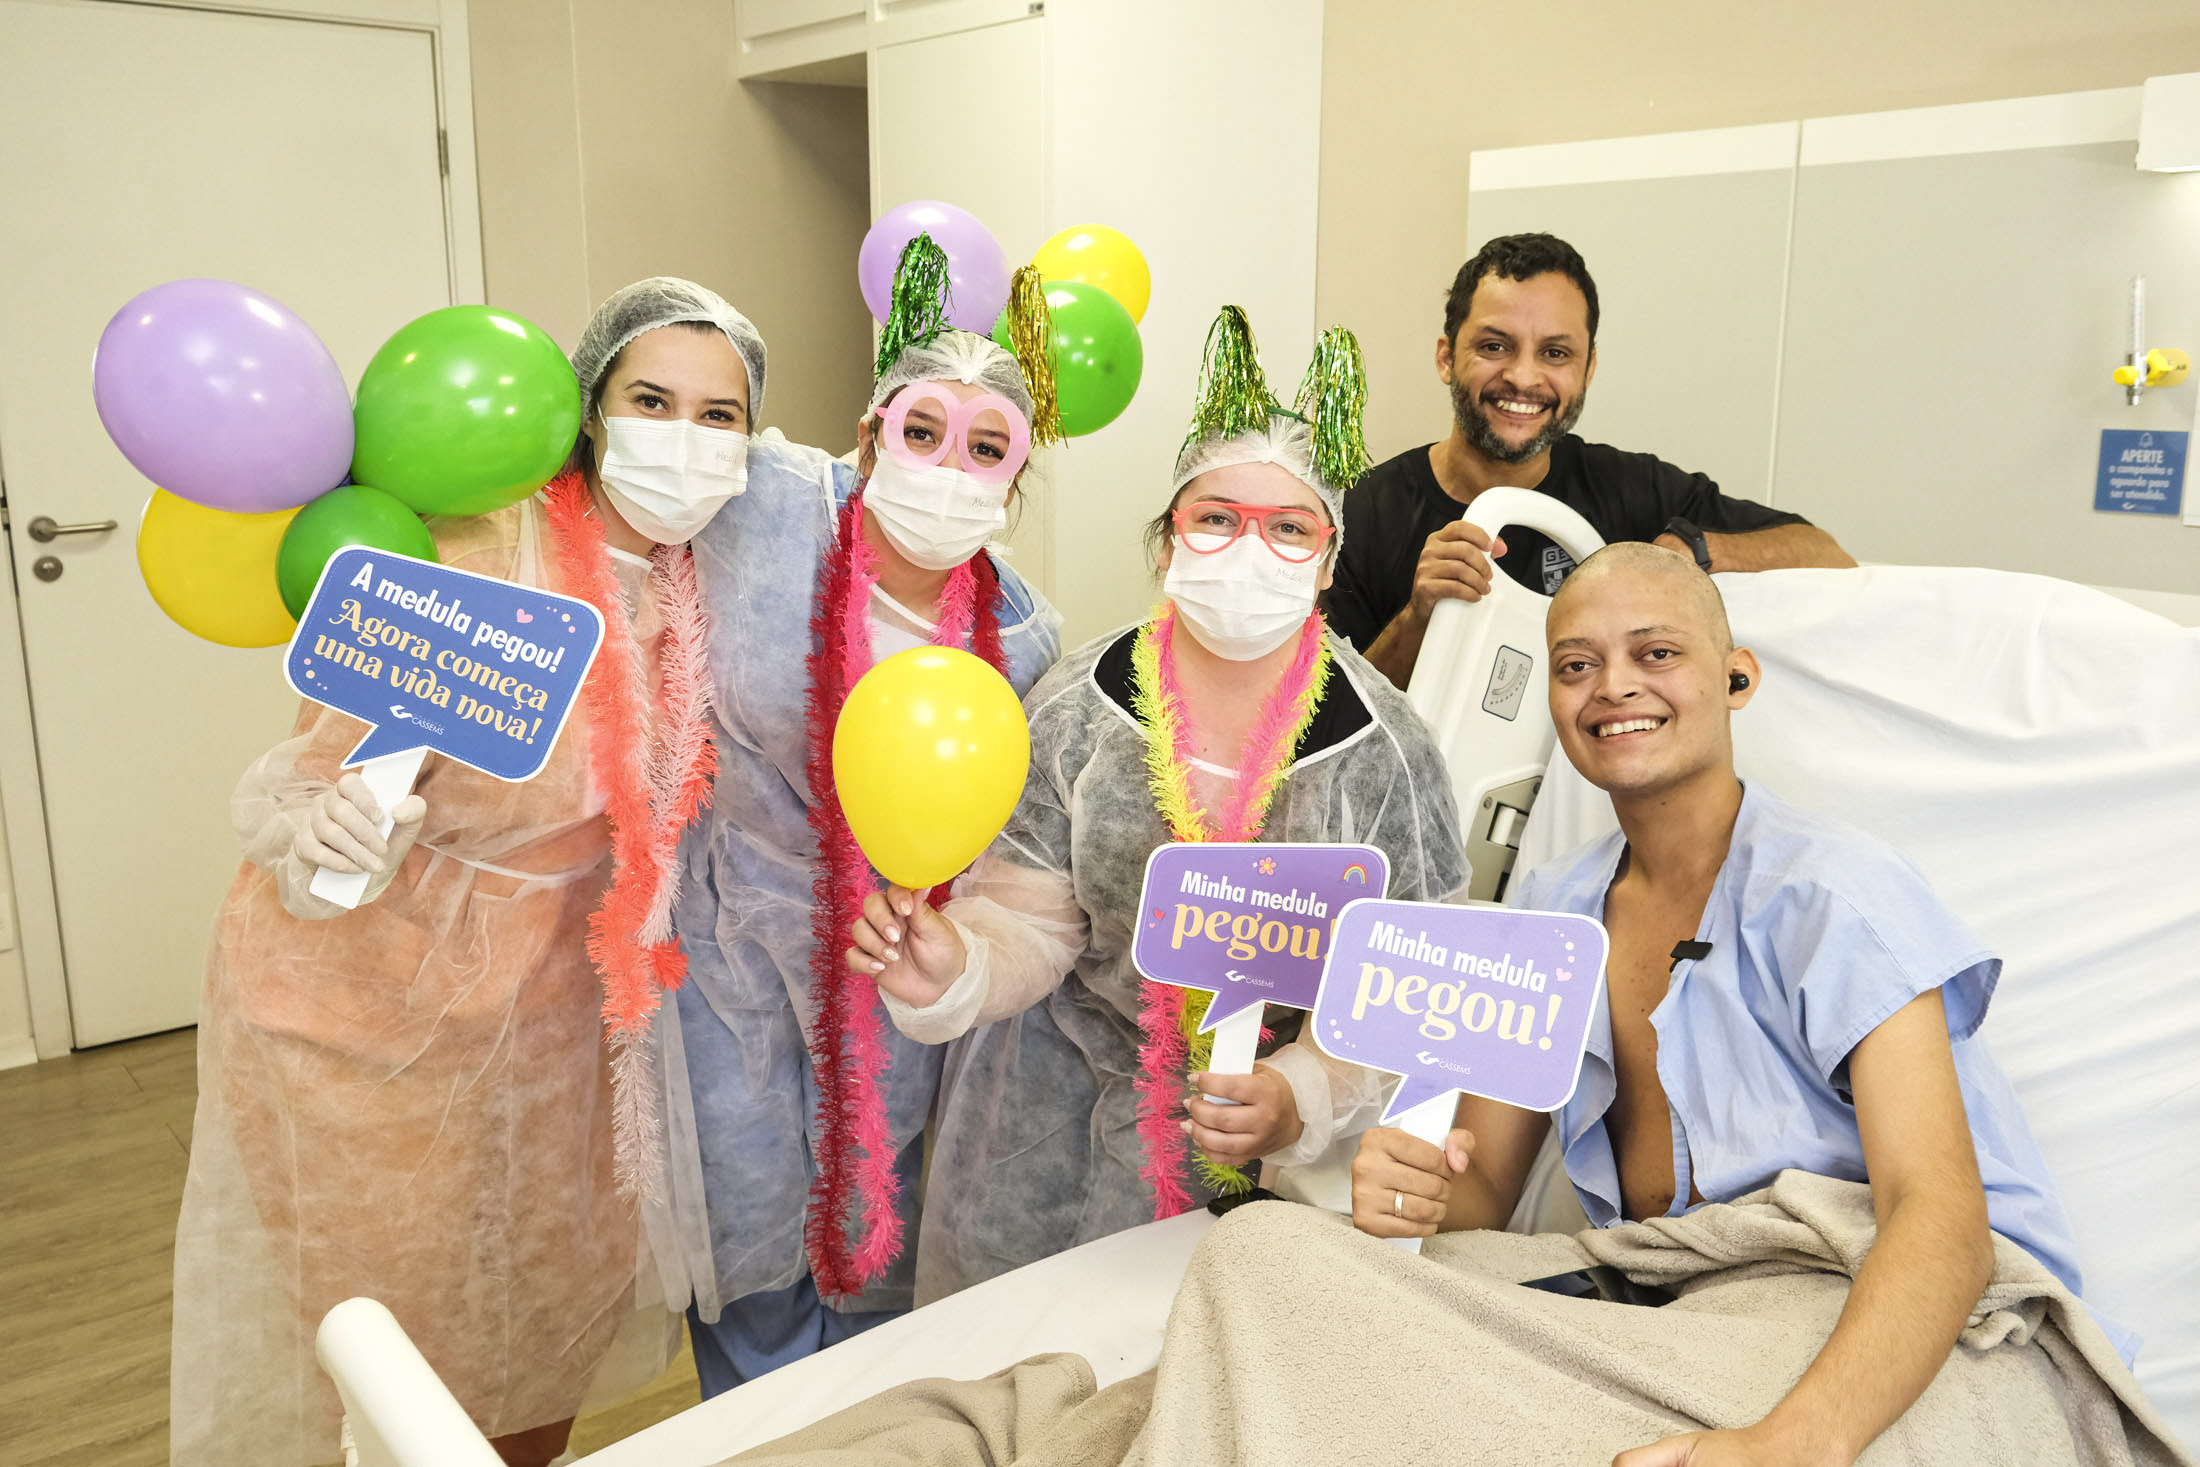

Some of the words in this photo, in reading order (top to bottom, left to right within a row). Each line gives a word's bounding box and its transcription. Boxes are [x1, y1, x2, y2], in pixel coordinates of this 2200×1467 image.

[2121, 449, 2164, 464] APERTE
[350, 562, 374, 592] A
[375, 576, 472, 635] medula
[471, 621, 566, 674] pegou!
[328, 598, 431, 660] Agora
[436, 650, 549, 712] começa
[313, 633, 383, 679] uma
[389, 665, 452, 708] vida
[455, 694, 544, 745] nova!
[411, 716, 445, 736] CASSEMS
[1179, 870, 1246, 904] Minha
[1250, 888, 1328, 919] medula
[1245, 976, 1275, 989] CASSEMS
[1367, 920, 1449, 967] Minha
[1452, 952, 1548, 994] medula
[1351, 962, 1563, 1051] pegou!
[1438, 1059, 1472, 1076] CASSEMS
